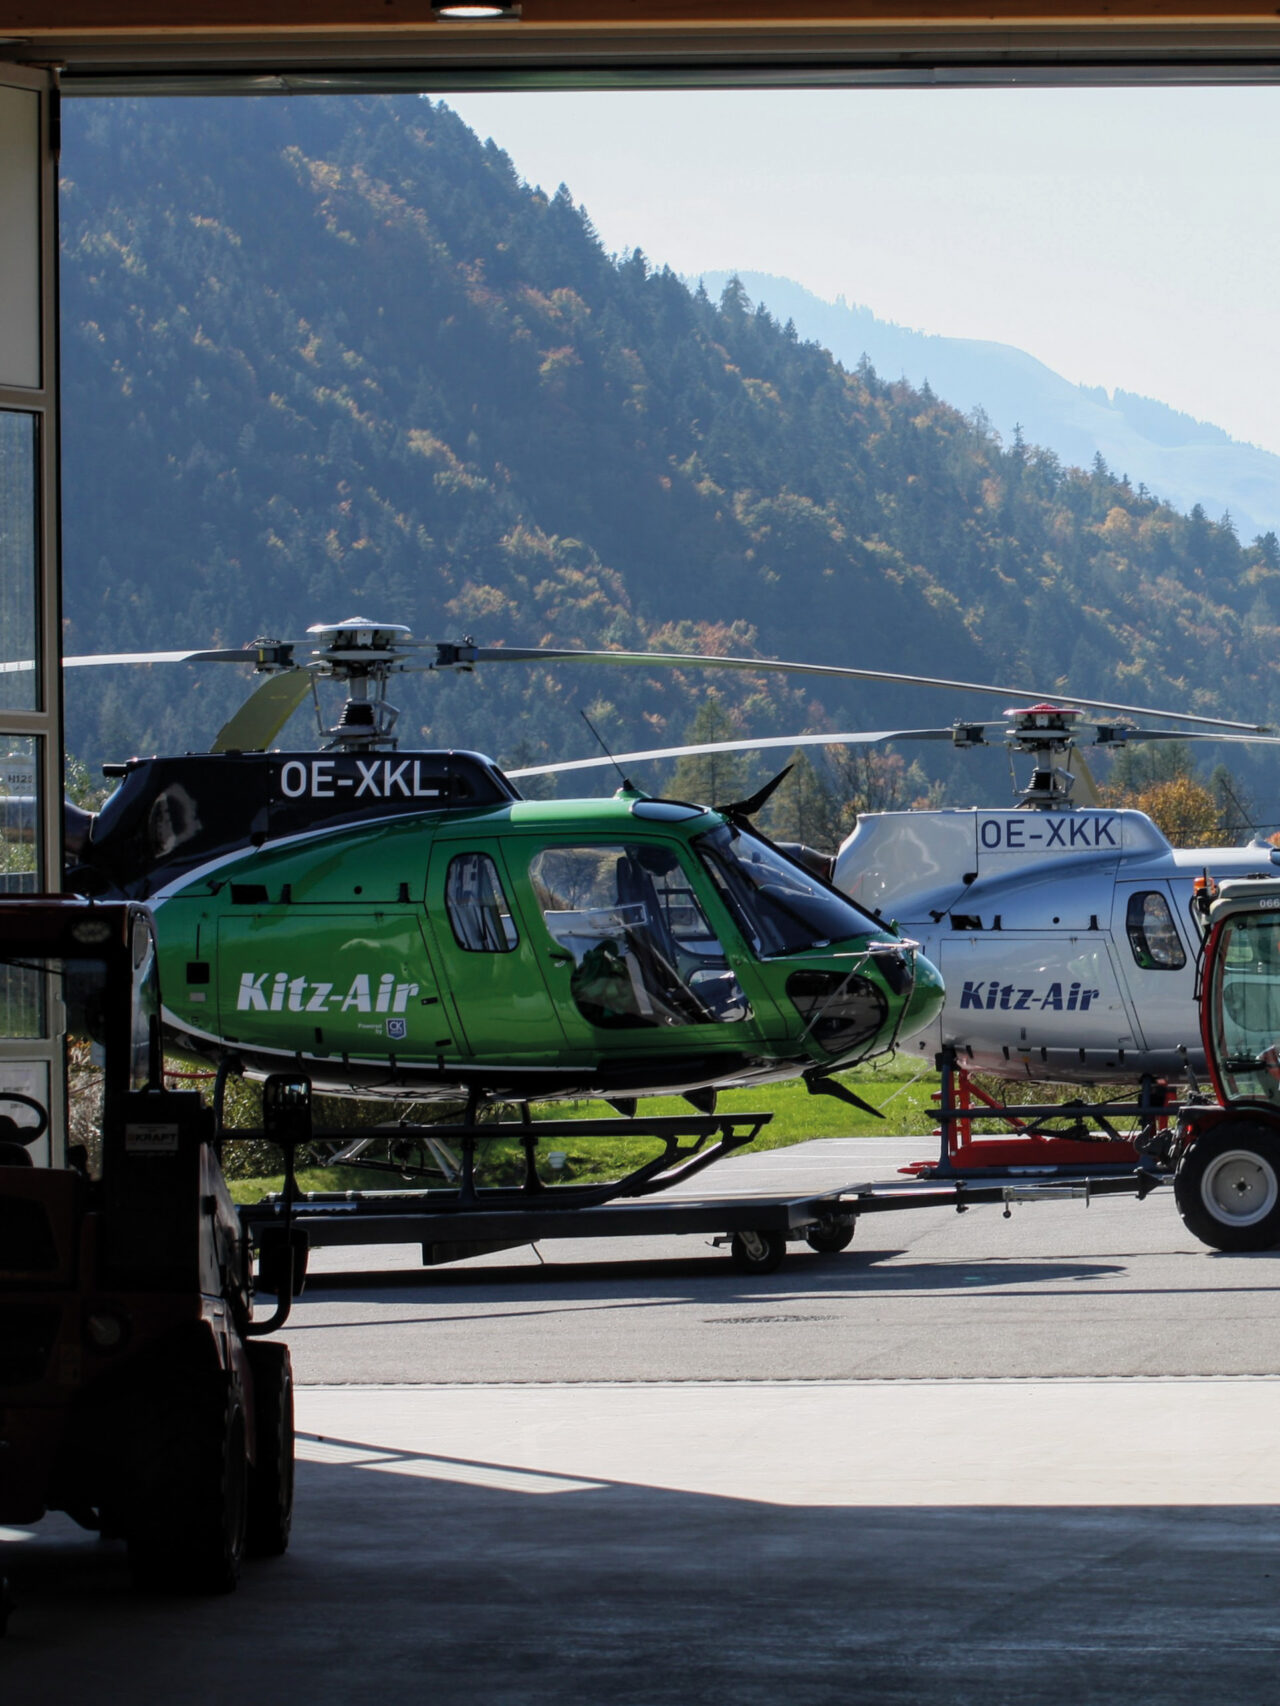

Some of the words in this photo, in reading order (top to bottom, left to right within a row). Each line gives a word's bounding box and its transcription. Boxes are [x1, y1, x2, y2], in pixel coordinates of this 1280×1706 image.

[280, 760, 439, 798] OE-XKL
[981, 817, 1116, 849] OE-XKK
[236, 972, 420, 1013] Kitz-Air
[960, 981, 1099, 1011] Kitz-Air
